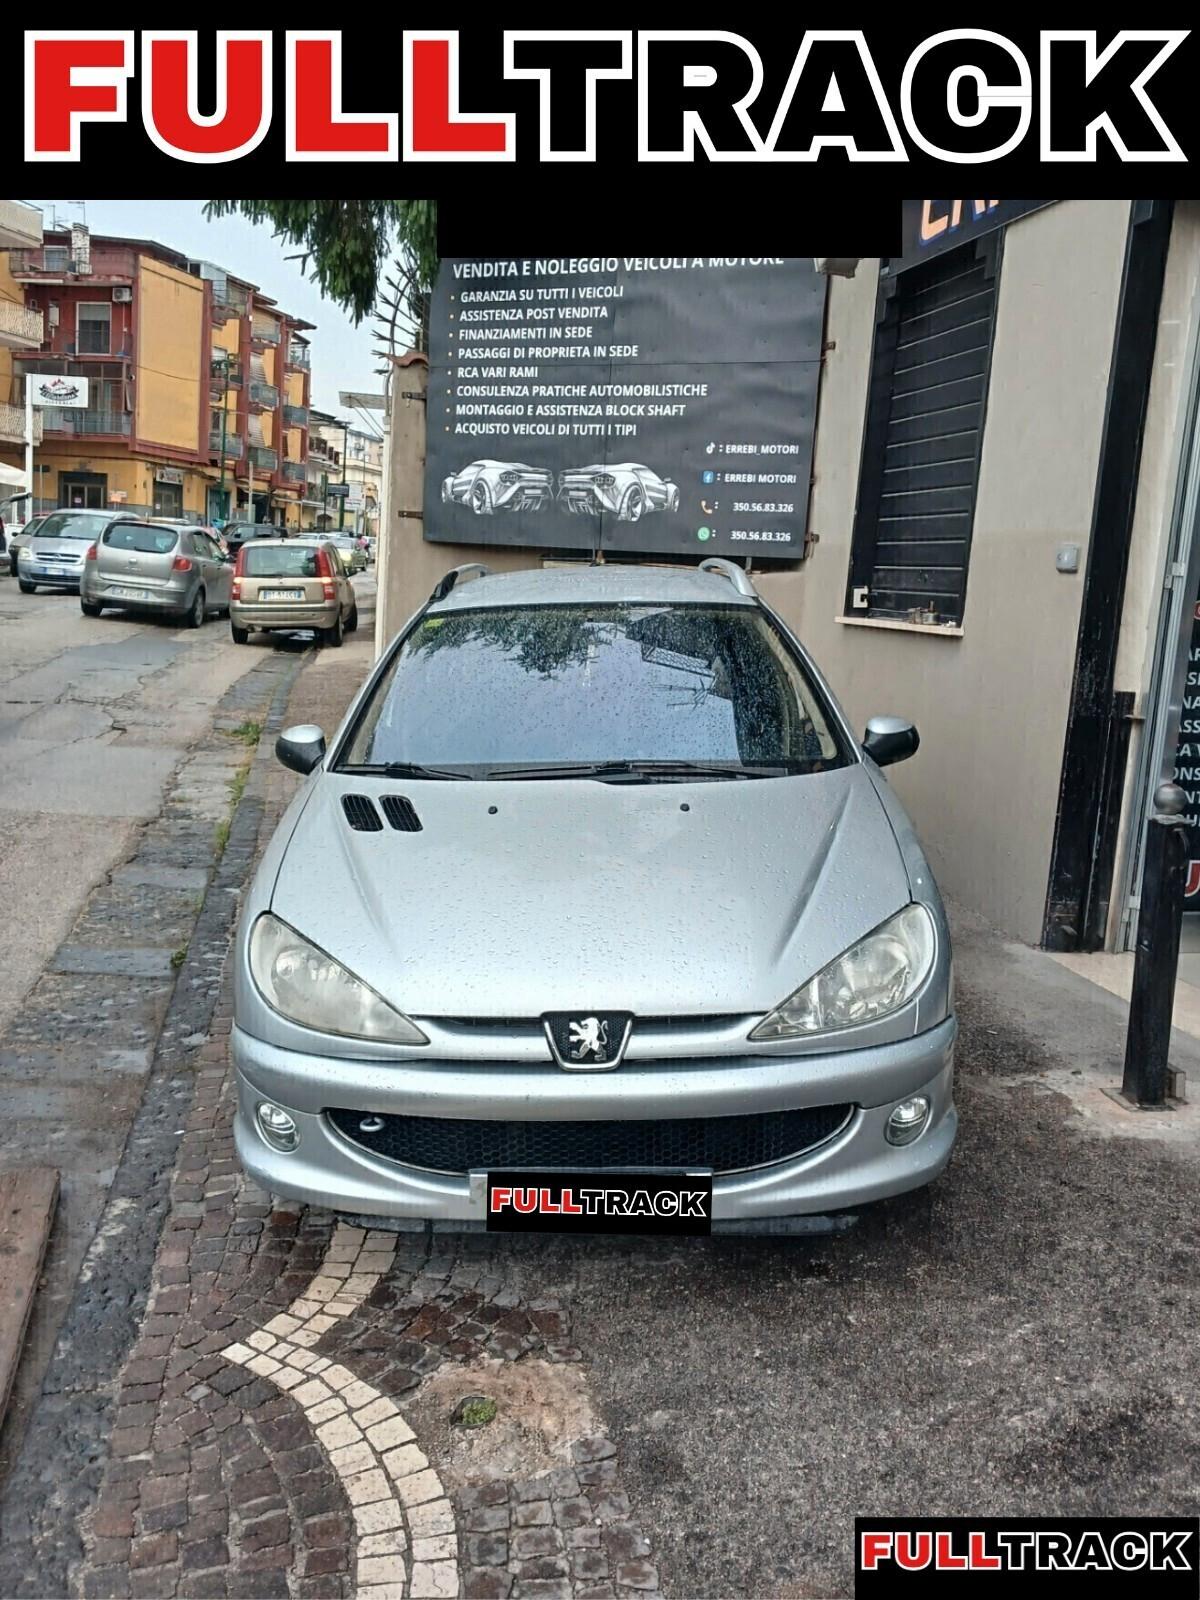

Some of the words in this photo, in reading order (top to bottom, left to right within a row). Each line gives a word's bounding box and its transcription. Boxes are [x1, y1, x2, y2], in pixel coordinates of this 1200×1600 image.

[453, 261, 518, 279] VENDITA
[522, 261, 532, 276] E
[535, 258, 618, 275] NOLEGGIO
[624, 258, 687, 271] VEICOLI
[460, 289, 517, 303] GARANZIA
[519, 289, 534, 301] SU
[537, 287, 569, 300] TUTTI
[571, 288, 576, 299] I
[578, 286, 623, 299] VEICOLI
[459, 308, 524, 322] ASSISTENZA
[526, 308, 555, 320] POST
[557, 306, 608, 319] VENDITA
[459, 328, 547, 341] FINANZIAMENTI
[549, 328, 562, 339] IN
[564, 326, 593, 339] SEDE
[458, 347, 511, 360] PASSAGGI
[513, 347, 525, 359] DI
[528, 346, 591, 359] PROPRIETA
[593, 346, 606, 357] IN
[609, 345, 638, 357] SEDE
[457, 367, 479, 379] RCA
[481, 366, 506, 378] VARI
[509, 366, 538, 378] RAMI
[456, 385, 530, 397] CONSULENZA
[532, 385, 587, 397] PRATICHE
[588, 384, 708, 397] AUTOMOBILISTICHE
[456, 404, 525, 416] MONTAGGIO
[527, 404, 534, 416] E
[535, 404, 602, 417] ASSISTENZA
[605, 404, 646, 417] BLOCK
[647, 404, 686, 417] SHAFT
[454, 422, 510, 436] ACQUISTO
[512, 423, 555, 436] VEICOLI
[558, 423, 570, 436] DI
[573, 423, 605, 436] TUTTI
[607, 423, 612, 436] I
[615, 423, 637, 436] TIPI
[724, 473, 756, 483] ERREBI
[758, 474, 797, 484] MOTORI
[732, 502, 794, 513] 350.56.83.326
[730, 530, 791, 542] 350.56.83.326
